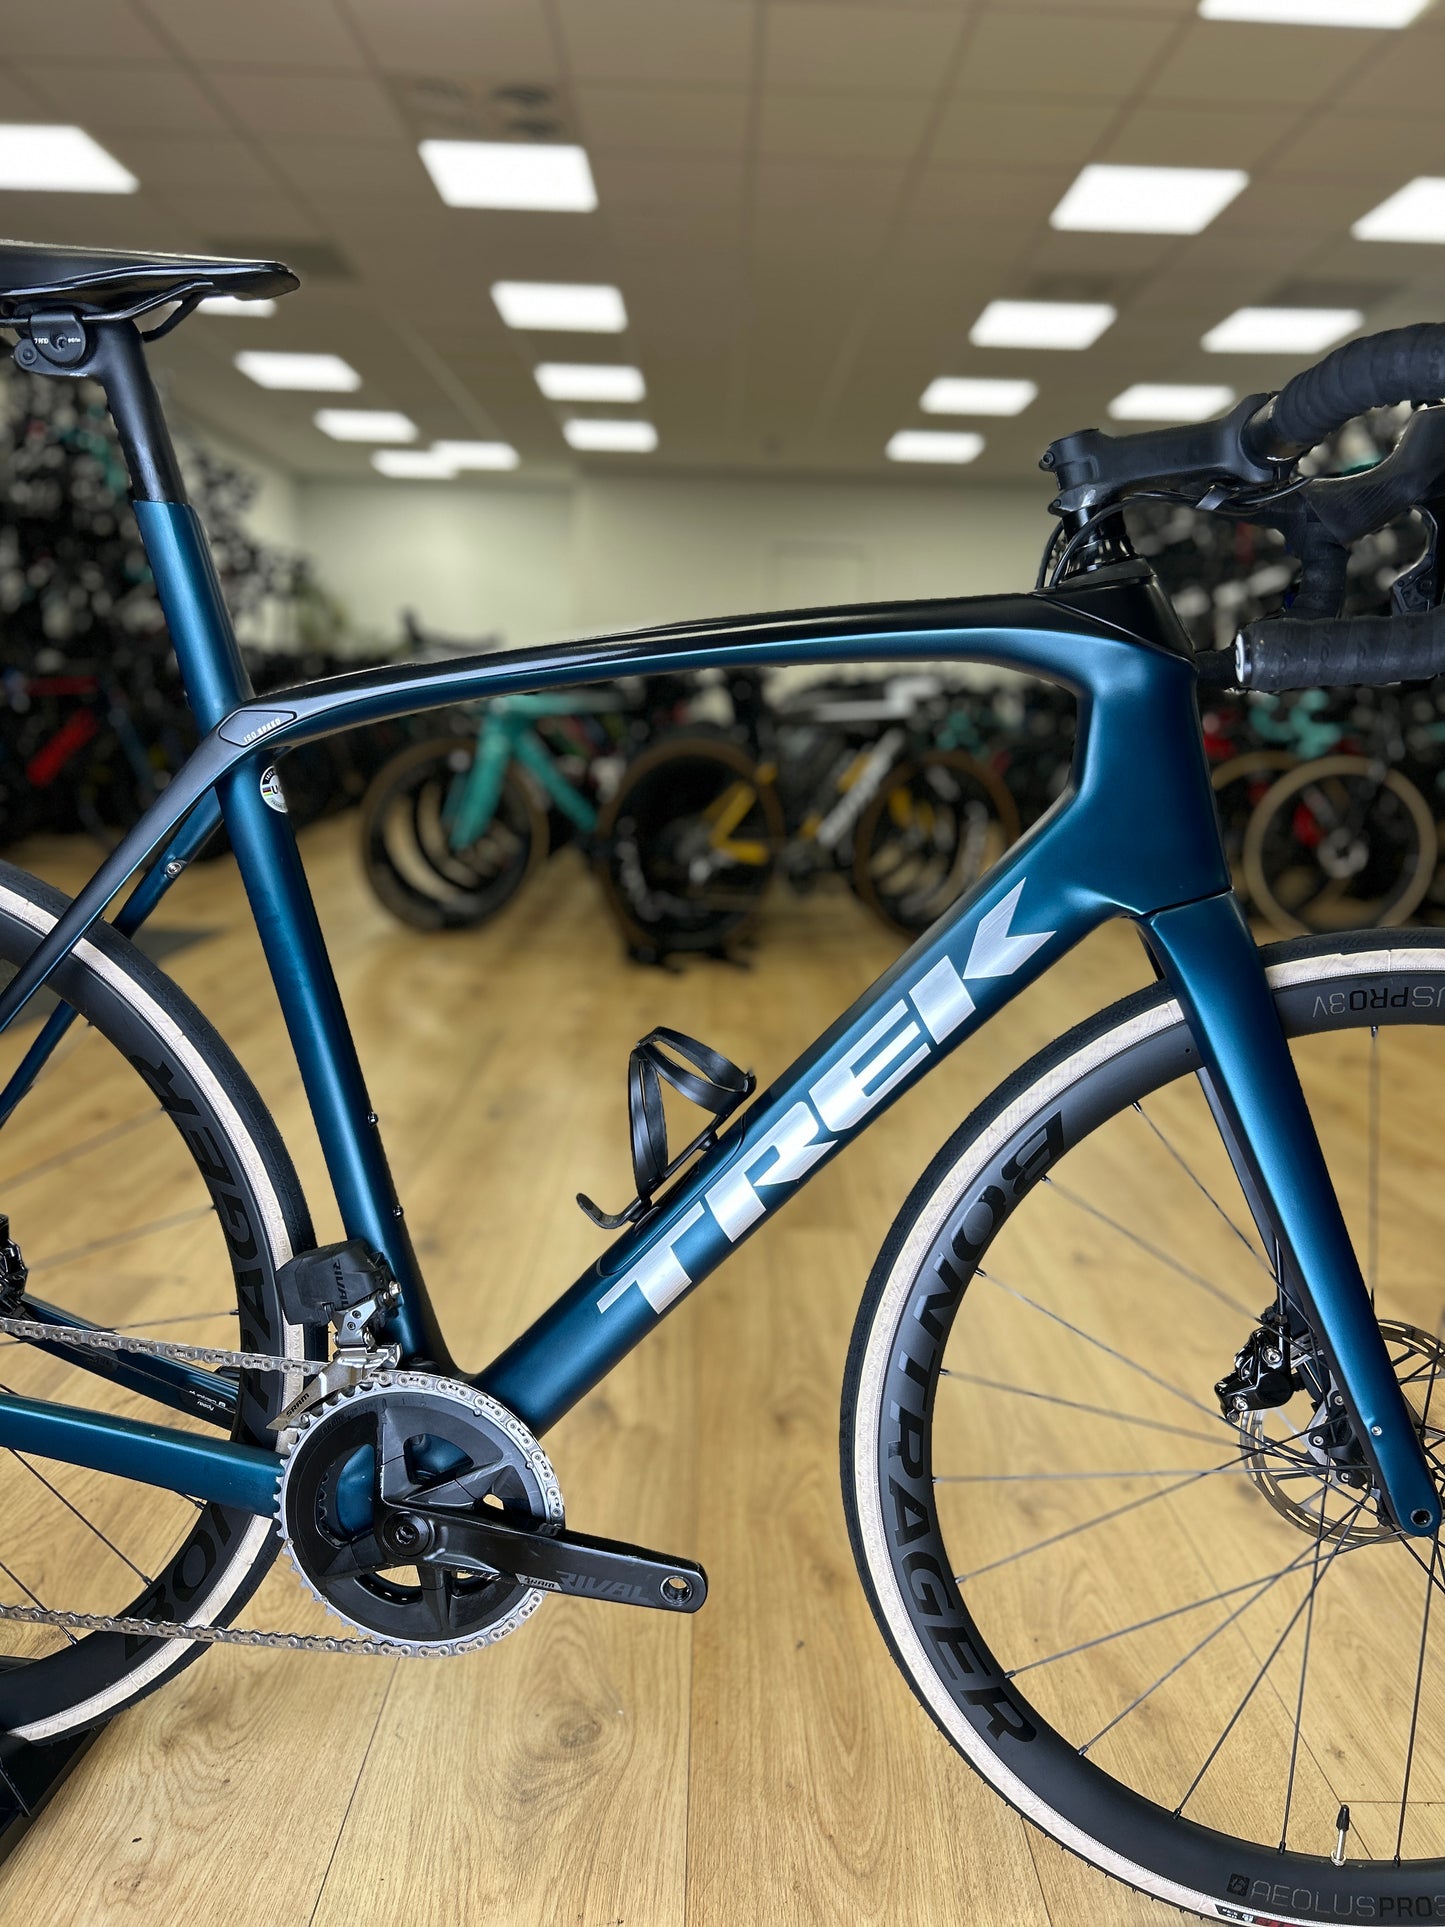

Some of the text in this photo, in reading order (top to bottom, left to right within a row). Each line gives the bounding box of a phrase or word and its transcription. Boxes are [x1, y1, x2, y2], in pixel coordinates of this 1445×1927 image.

[243, 731, 257, 743] ISO
[596, 876, 1057, 1315] TREK
[333, 1258, 349, 1309] RIVAL
[286, 1392, 310, 1418] SRAM
[888, 1109, 1065, 1742] BONTRAGER
[556, 1570, 651, 1601] RIVAL
